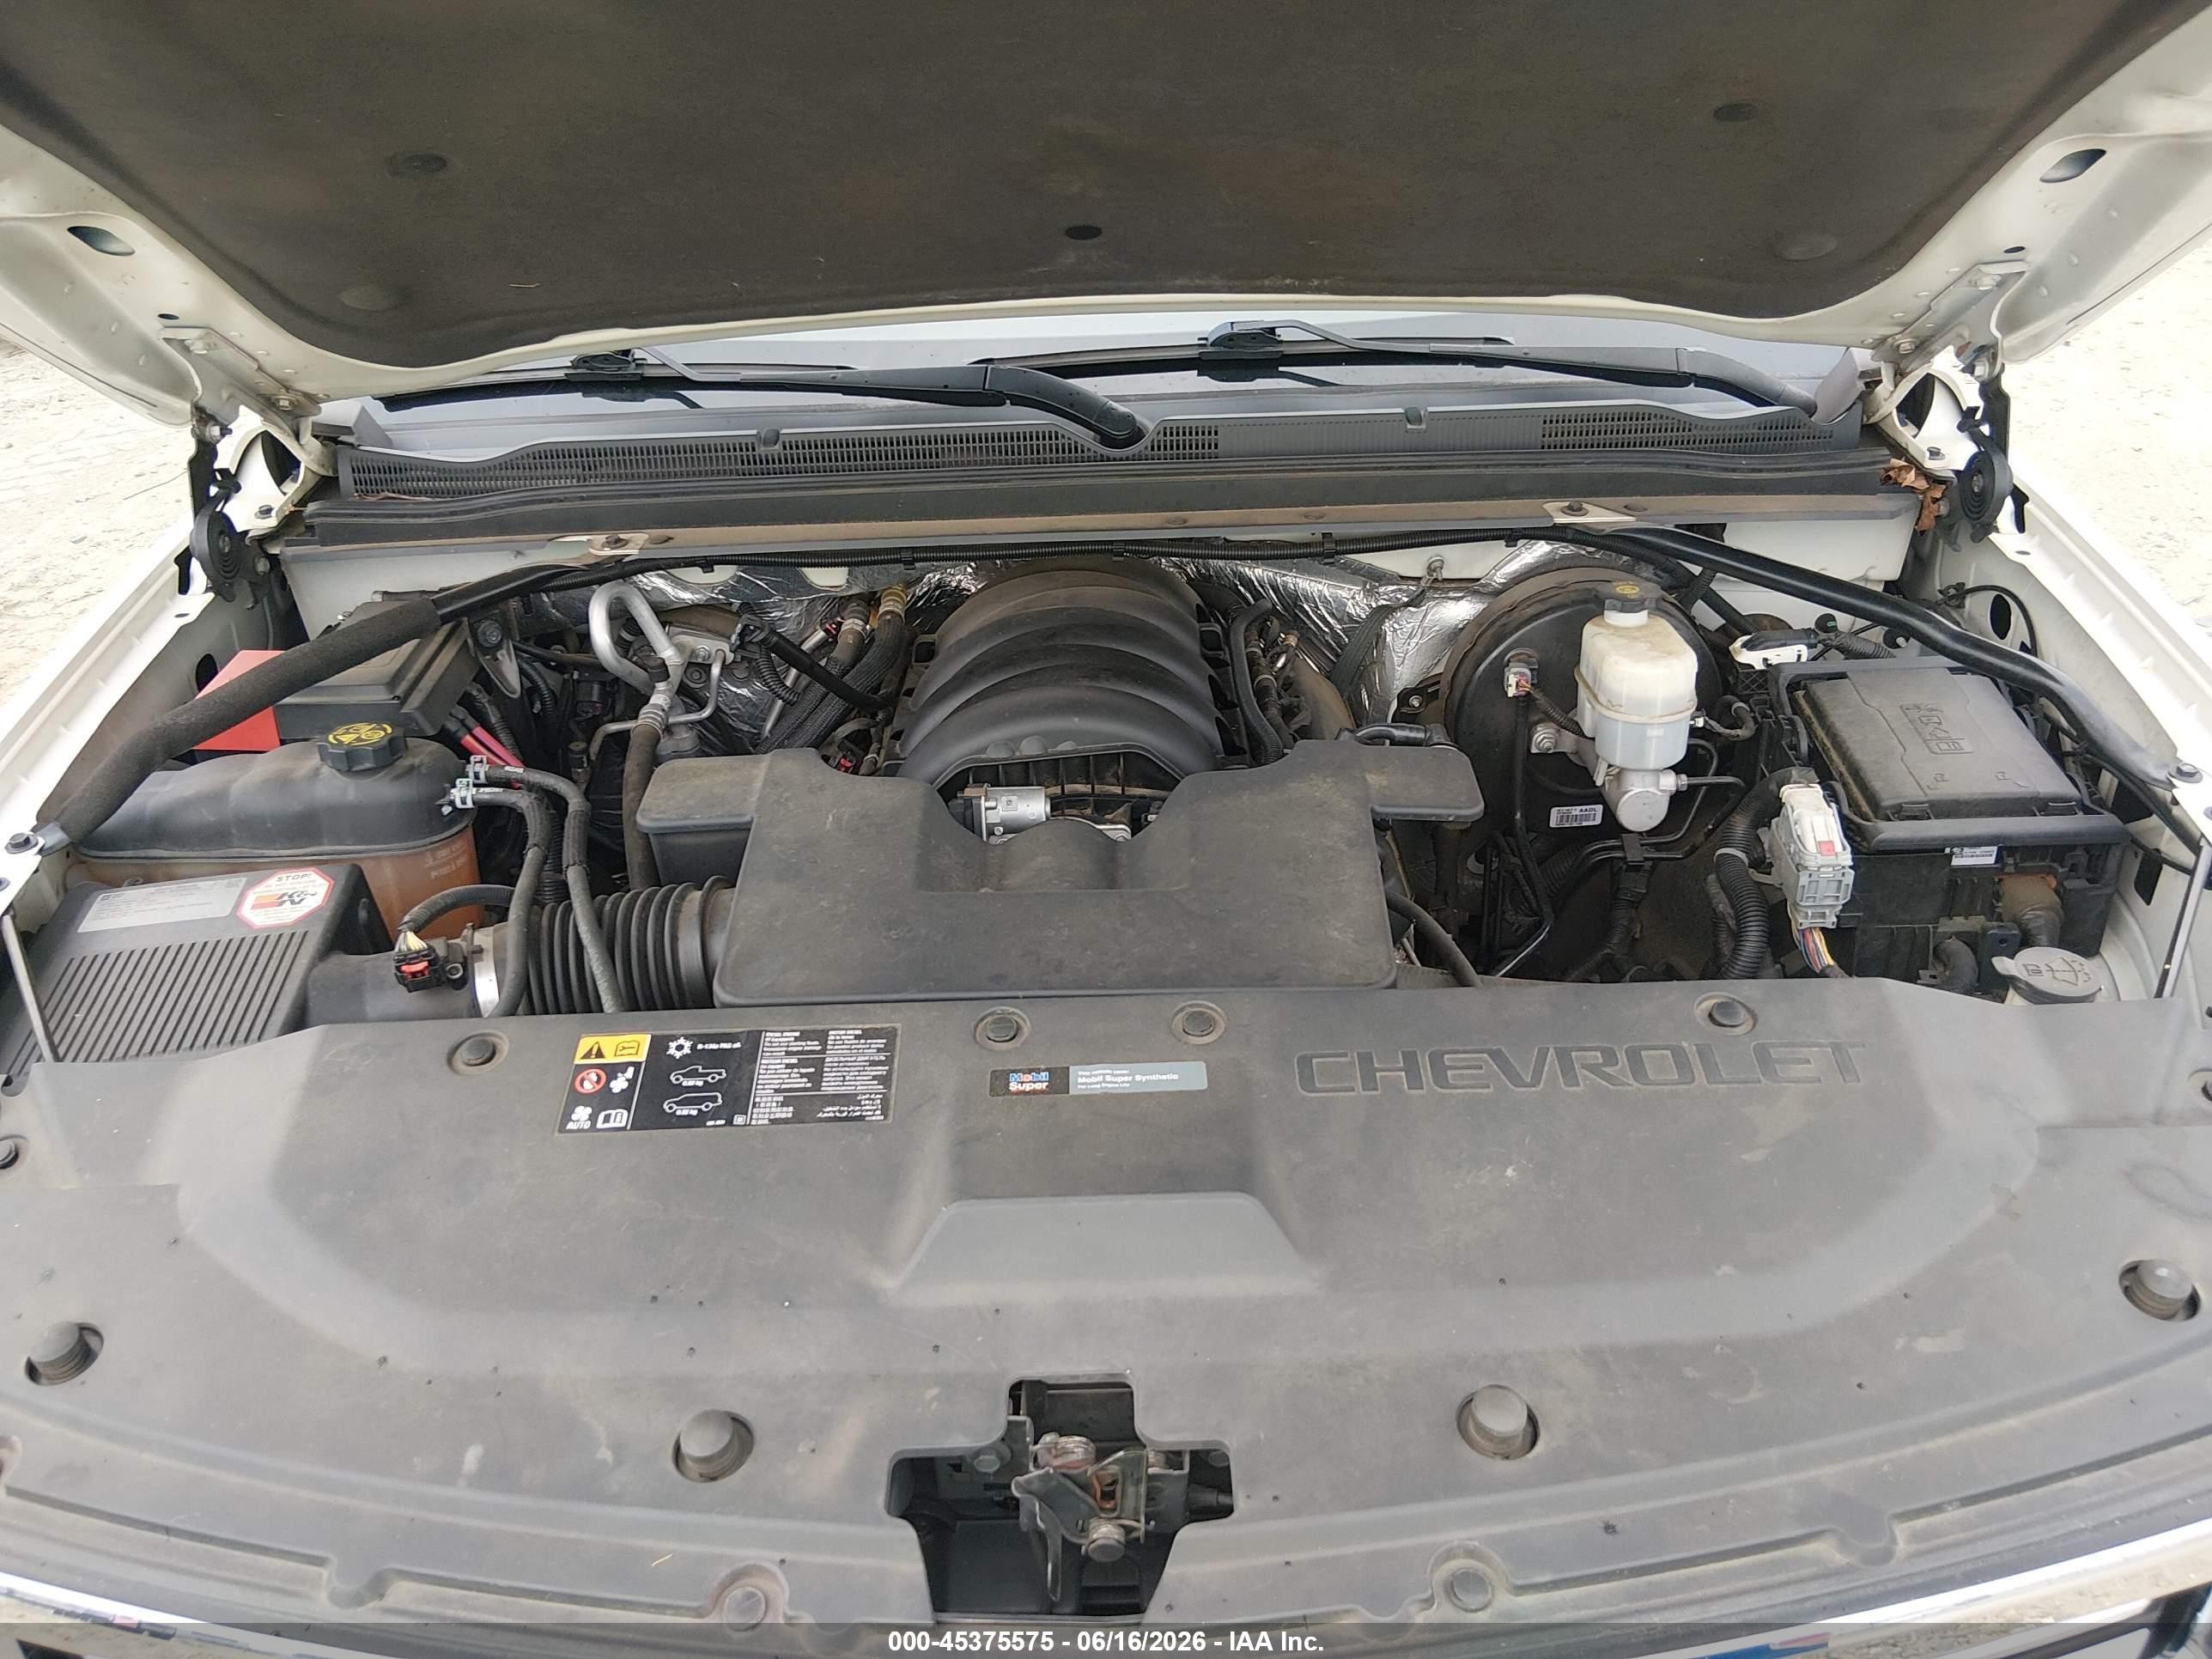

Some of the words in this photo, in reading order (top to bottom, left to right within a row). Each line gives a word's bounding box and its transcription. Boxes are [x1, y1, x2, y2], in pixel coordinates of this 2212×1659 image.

[276, 873, 313, 882] STOP!
[1294, 1040, 1866, 1096] CHEVROLET
[1009, 1072, 1049, 1082] Mobil
[1078, 1075, 1103, 1084] Mobil
[1105, 1074, 1133, 1083] Super
[1134, 1073, 1179, 1082] Synthetic
[1008, 1082, 1048, 1091] Super
[566, 1120, 592, 1130] AUTO
